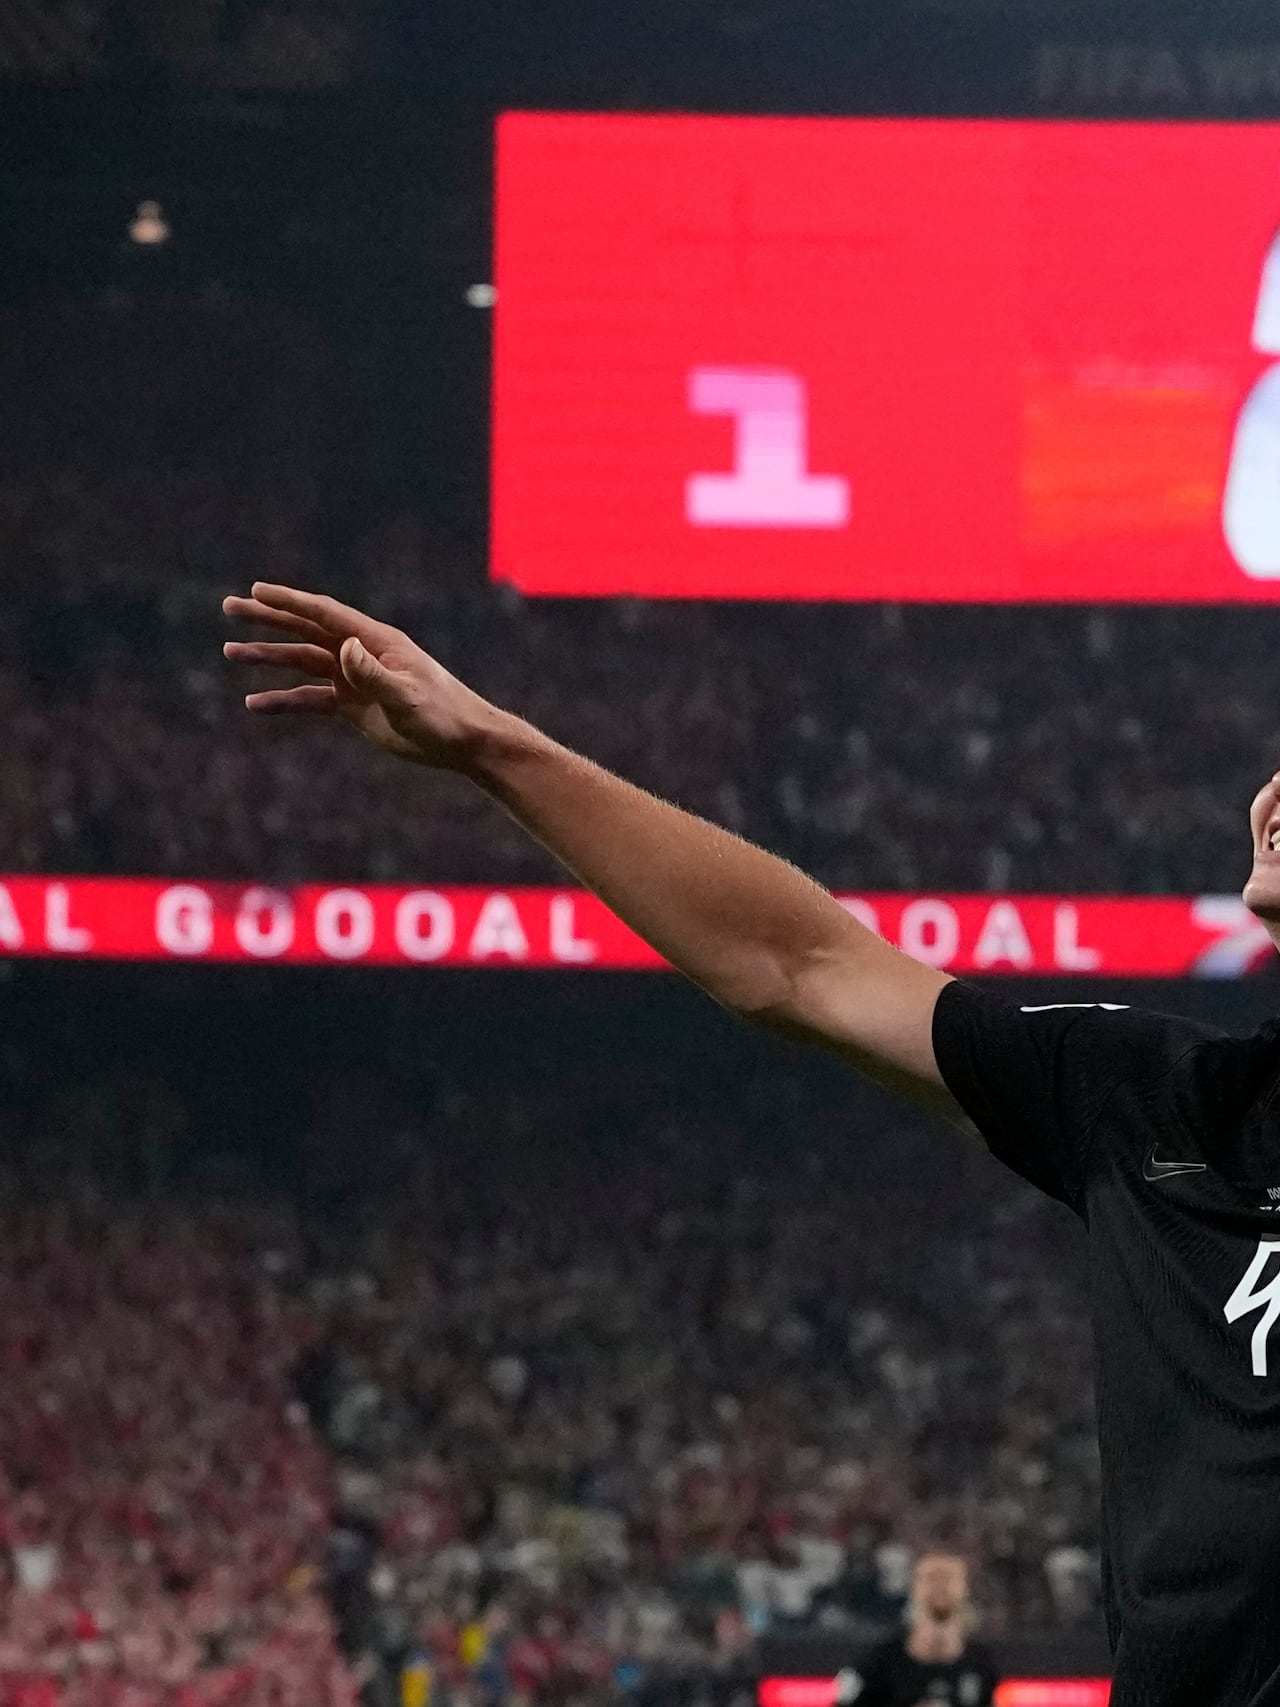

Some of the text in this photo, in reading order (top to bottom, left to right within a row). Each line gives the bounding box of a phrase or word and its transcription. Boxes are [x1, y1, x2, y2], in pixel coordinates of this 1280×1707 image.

[1035, 44, 1190, 98] FIFA
[685, 366, 851, 529] 1
[154, 884, 598, 963] GOOOAL
